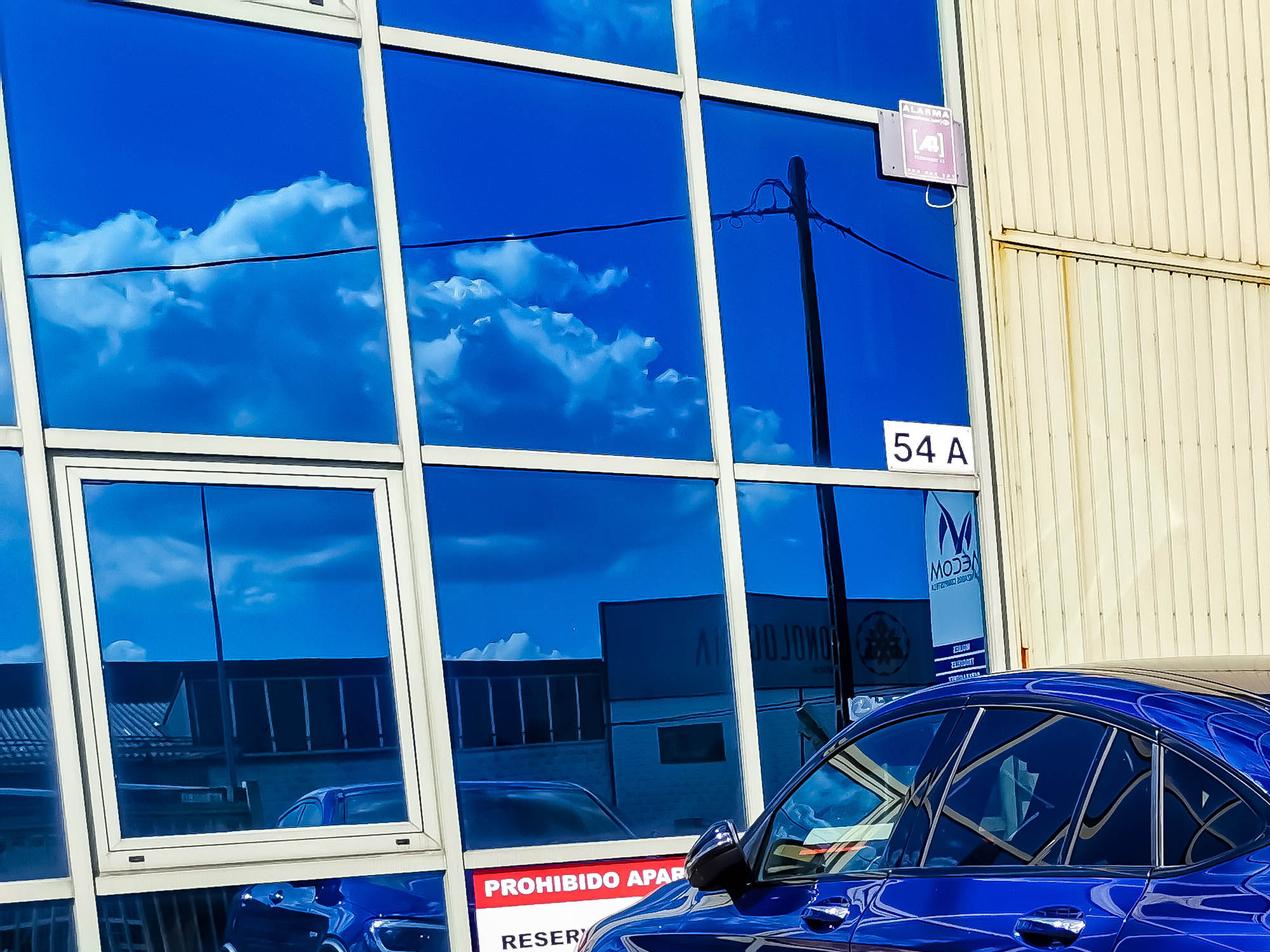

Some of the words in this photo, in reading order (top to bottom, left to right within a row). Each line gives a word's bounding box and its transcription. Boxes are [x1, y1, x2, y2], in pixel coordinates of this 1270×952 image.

[903, 104, 950, 119] ALARMA
[894, 432, 936, 463] 54
[947, 437, 968, 465] A
[484, 873, 621, 897] PROHIBIDO
[626, 866, 686, 887] APAR
[501, 928, 586, 950] RESER
